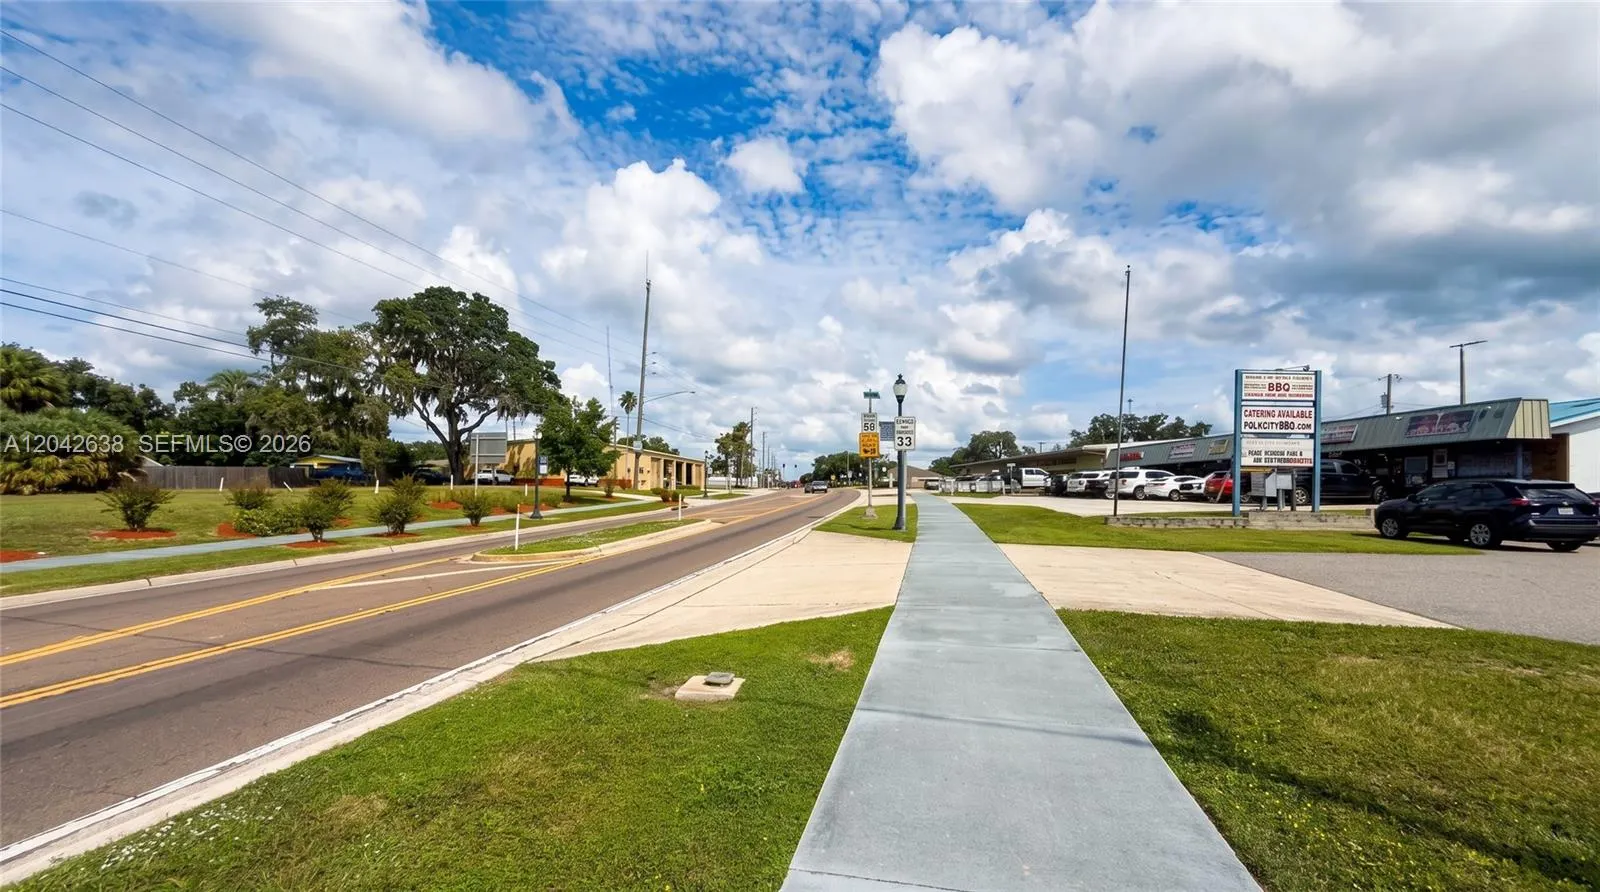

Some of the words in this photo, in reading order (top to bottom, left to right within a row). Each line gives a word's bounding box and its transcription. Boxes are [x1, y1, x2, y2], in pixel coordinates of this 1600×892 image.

[1268, 382, 1290, 392] BBQ
[1244, 410, 1276, 418] CATERING
[1277, 410, 1313, 419] AVAILABLE
[864, 423, 875, 431] 58
[897, 436, 912, 447] 33
